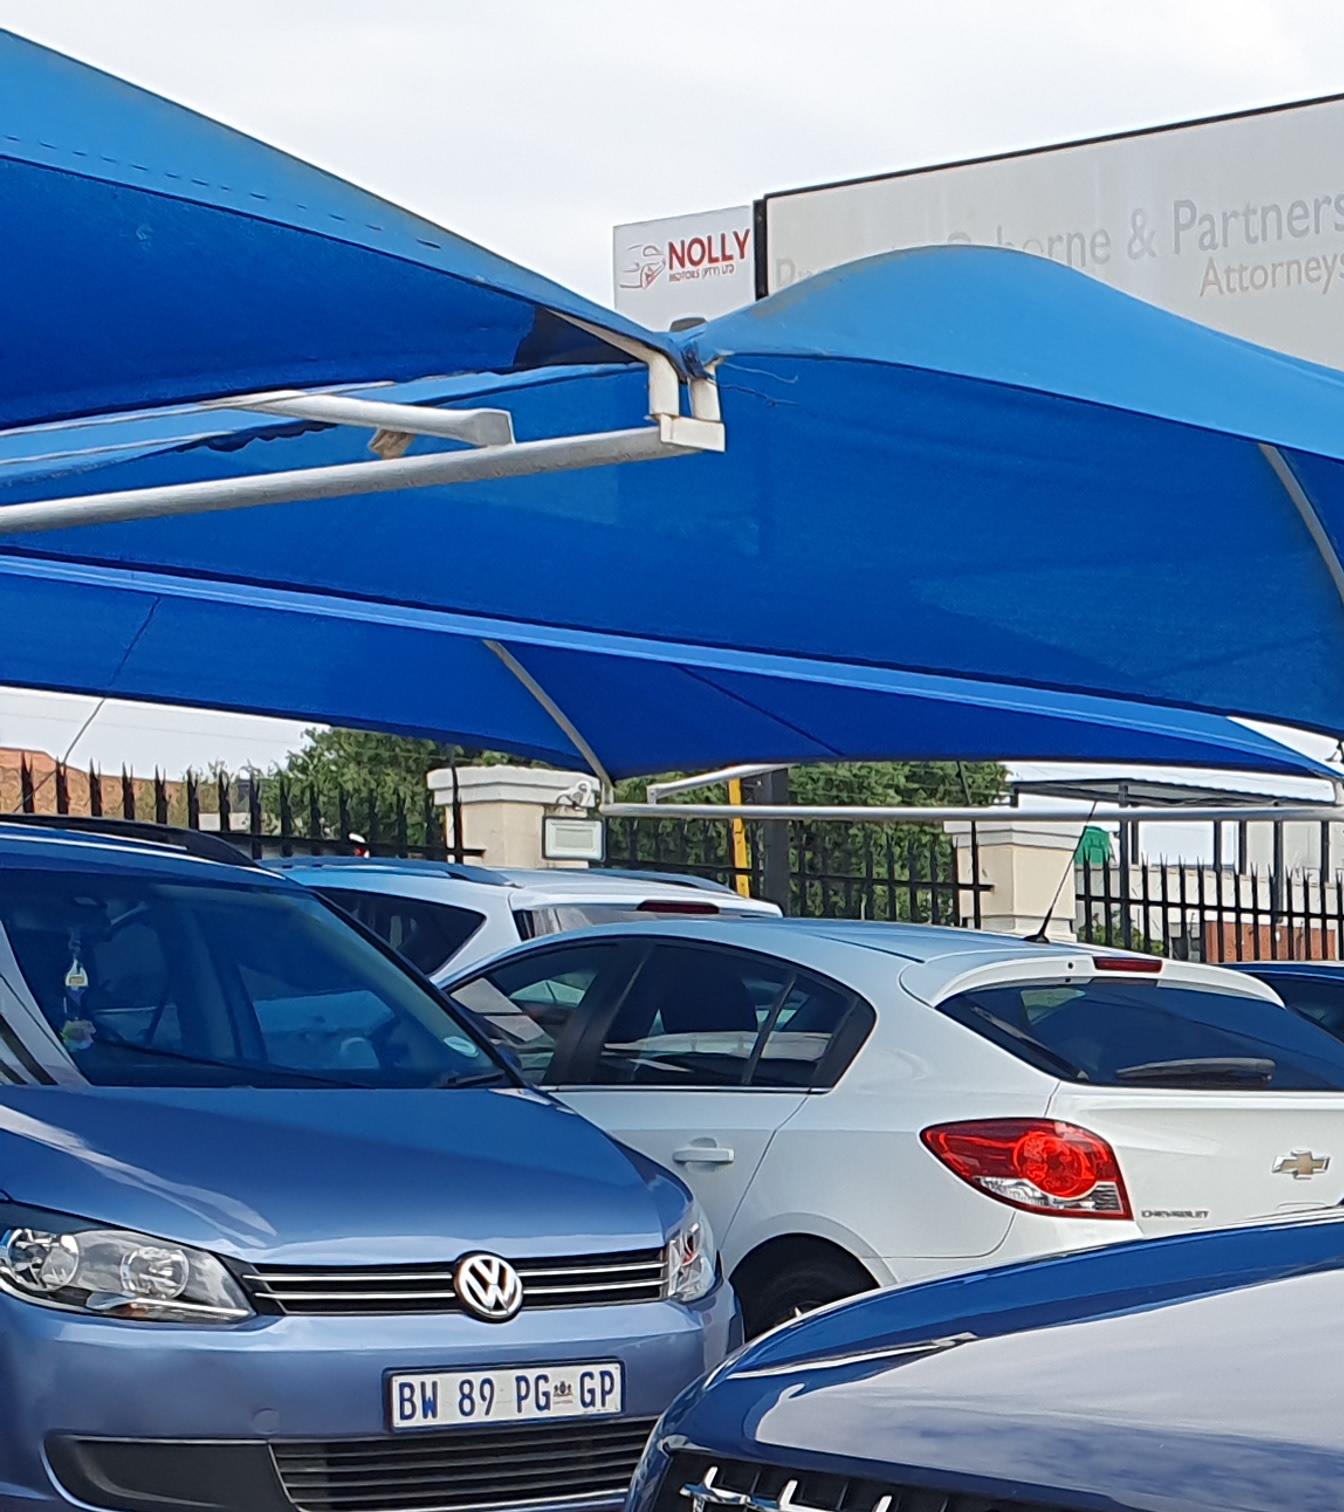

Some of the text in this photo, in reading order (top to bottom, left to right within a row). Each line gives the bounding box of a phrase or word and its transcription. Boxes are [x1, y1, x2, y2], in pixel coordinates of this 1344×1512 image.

[667, 228, 751, 271] NOLLY
[1127, 207, 1158, 261] &
[668, 269, 700, 282] MOTORS
[399, 1369, 616, 1421] BW 89 PG GP
